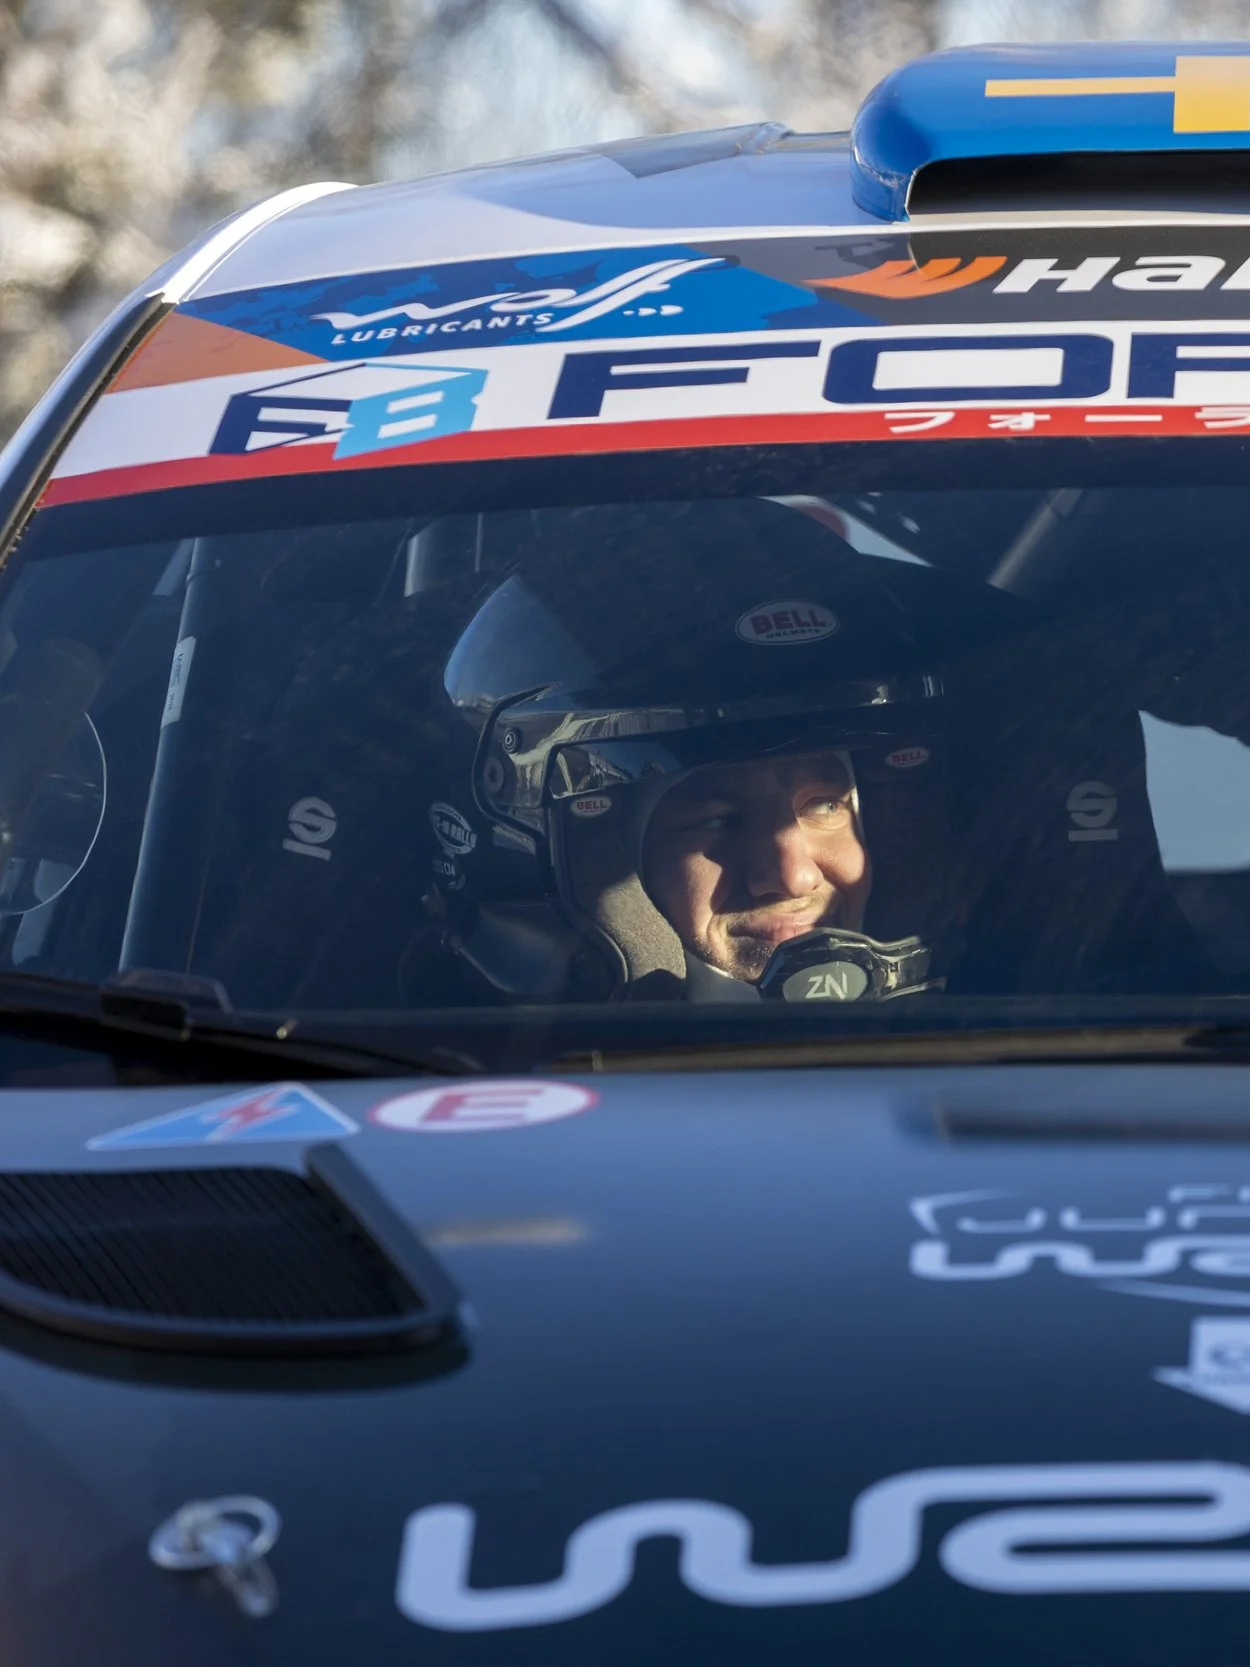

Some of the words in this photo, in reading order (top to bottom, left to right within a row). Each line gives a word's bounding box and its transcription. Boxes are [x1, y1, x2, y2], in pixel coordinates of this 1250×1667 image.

[331, 312, 555, 345] LUBRICANTS
[750, 609, 827, 636] BELL
[892, 750, 925, 763] BELL
[576, 799, 608, 811] BELL
[805, 969, 848, 1000] ZN
